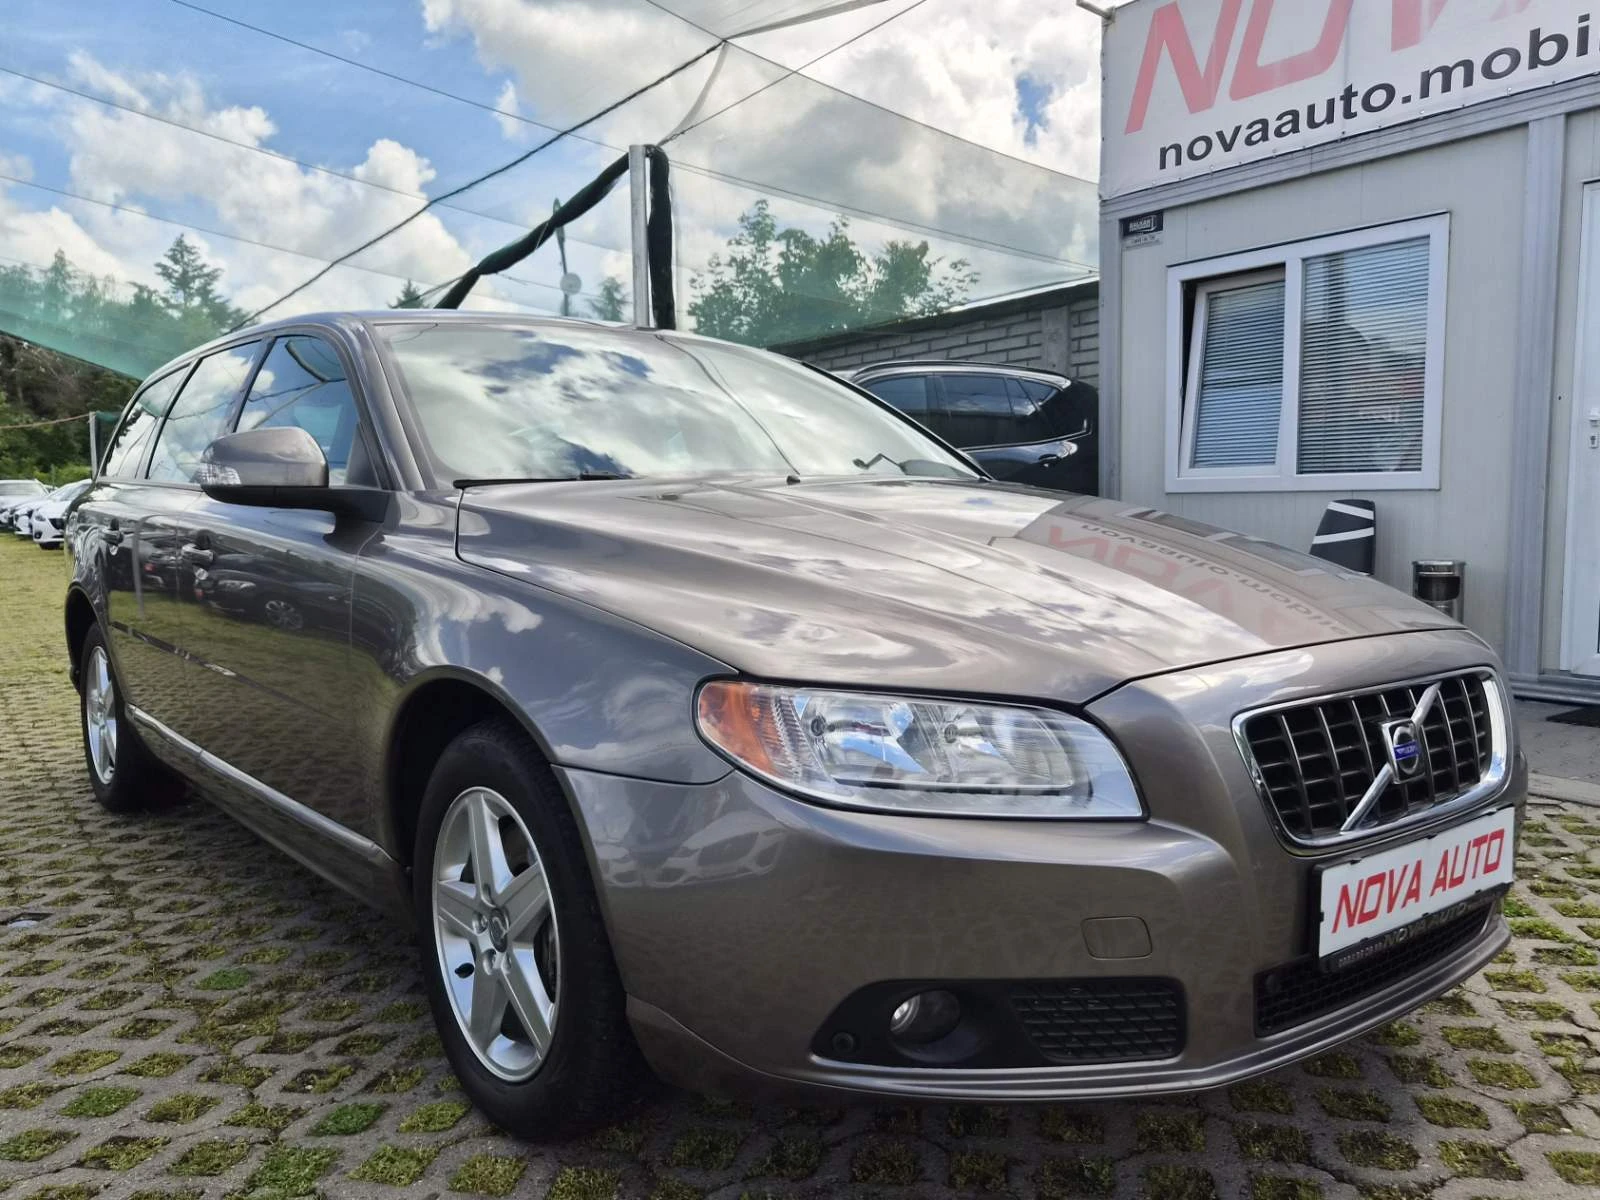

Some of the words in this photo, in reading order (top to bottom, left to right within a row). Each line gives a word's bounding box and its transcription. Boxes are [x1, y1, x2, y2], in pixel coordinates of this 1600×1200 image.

[1159, 13, 1600, 170] novaauto.mobi
[1332, 860, 1423, 934] NOVA
[1430, 828, 1505, 897] AUTO
